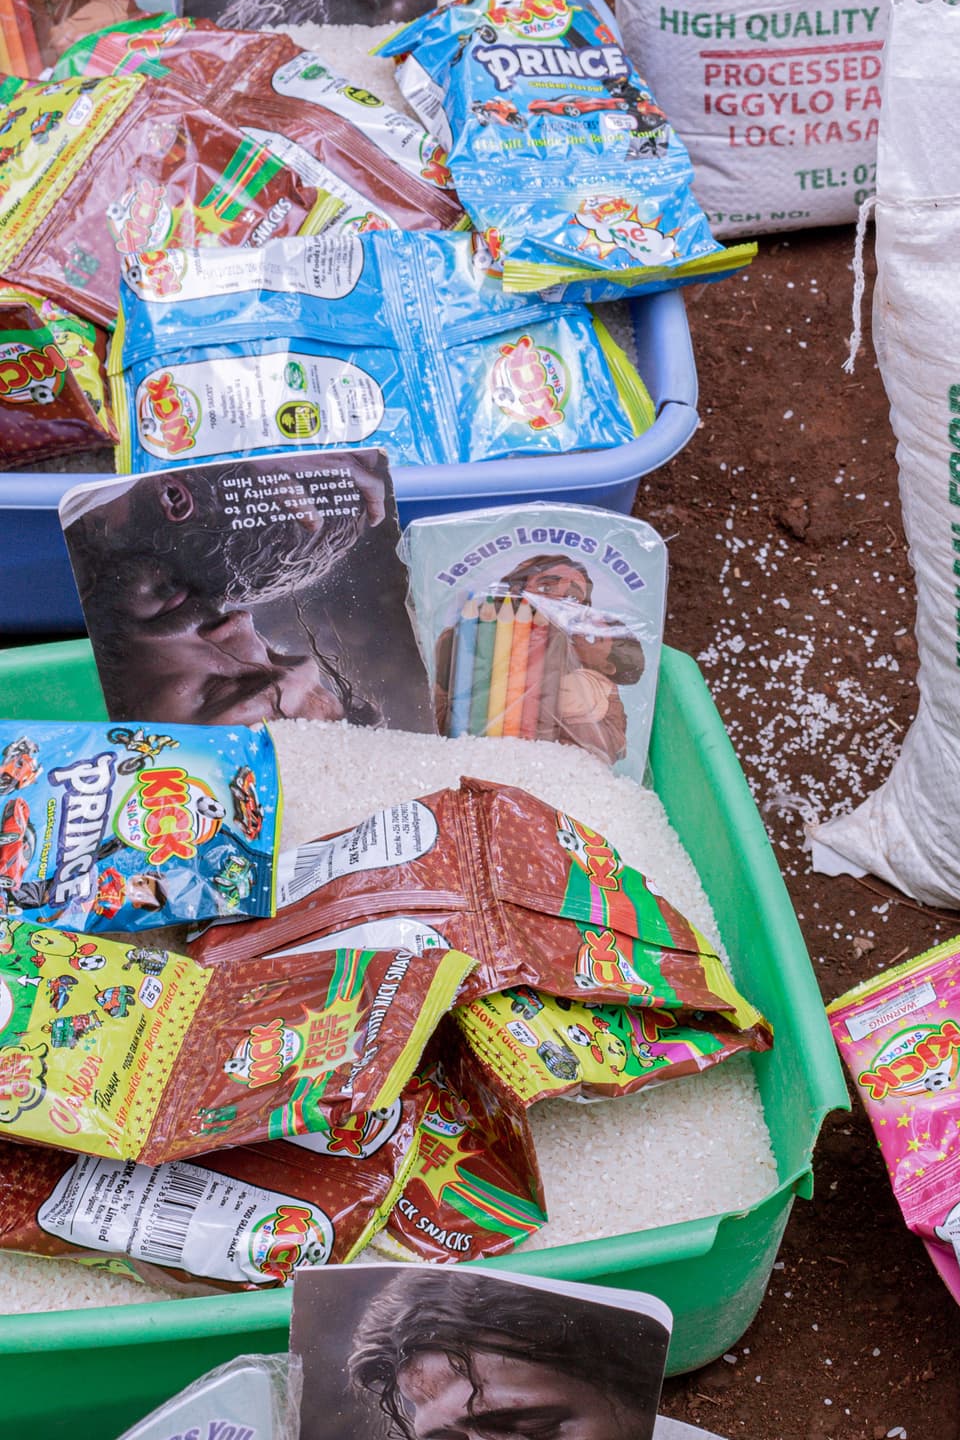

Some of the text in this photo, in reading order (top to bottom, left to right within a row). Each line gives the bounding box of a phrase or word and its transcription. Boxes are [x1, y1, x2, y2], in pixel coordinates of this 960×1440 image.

[660, 8, 878, 42] HIGH QUALITY
[474, 44, 630, 91] PRINCE
[700, 54, 881, 91] PROCESSED
[705, 90, 834, 116] IGGYLO
[729, 125, 796, 148] LOC:
[795, 168, 848, 190] TEL:
[147, 372, 196, 454] KICK
[223, 468, 350, 488] Heaven with Him
[225, 480, 354, 501] spend Eternity in
[232, 506, 359, 530] Jesus Loves YOU
[247, 502, 280, 512] YOU
[284, 497, 328, 506] wants
[437, 526, 644, 593] Jesus Loves You
[49, 752, 117, 906] PRINCE
[127, 799, 141, 841] SNACKS
[138, 767, 197, 866] KICK
[248, 1018, 285, 1088] KICK
[302, 1015, 331, 1070] FREE
[326, 1013, 350, 1062] GIFT
[881, 1032, 925, 1062] SNACKS
[416, 1216, 473, 1252] SNACKS
